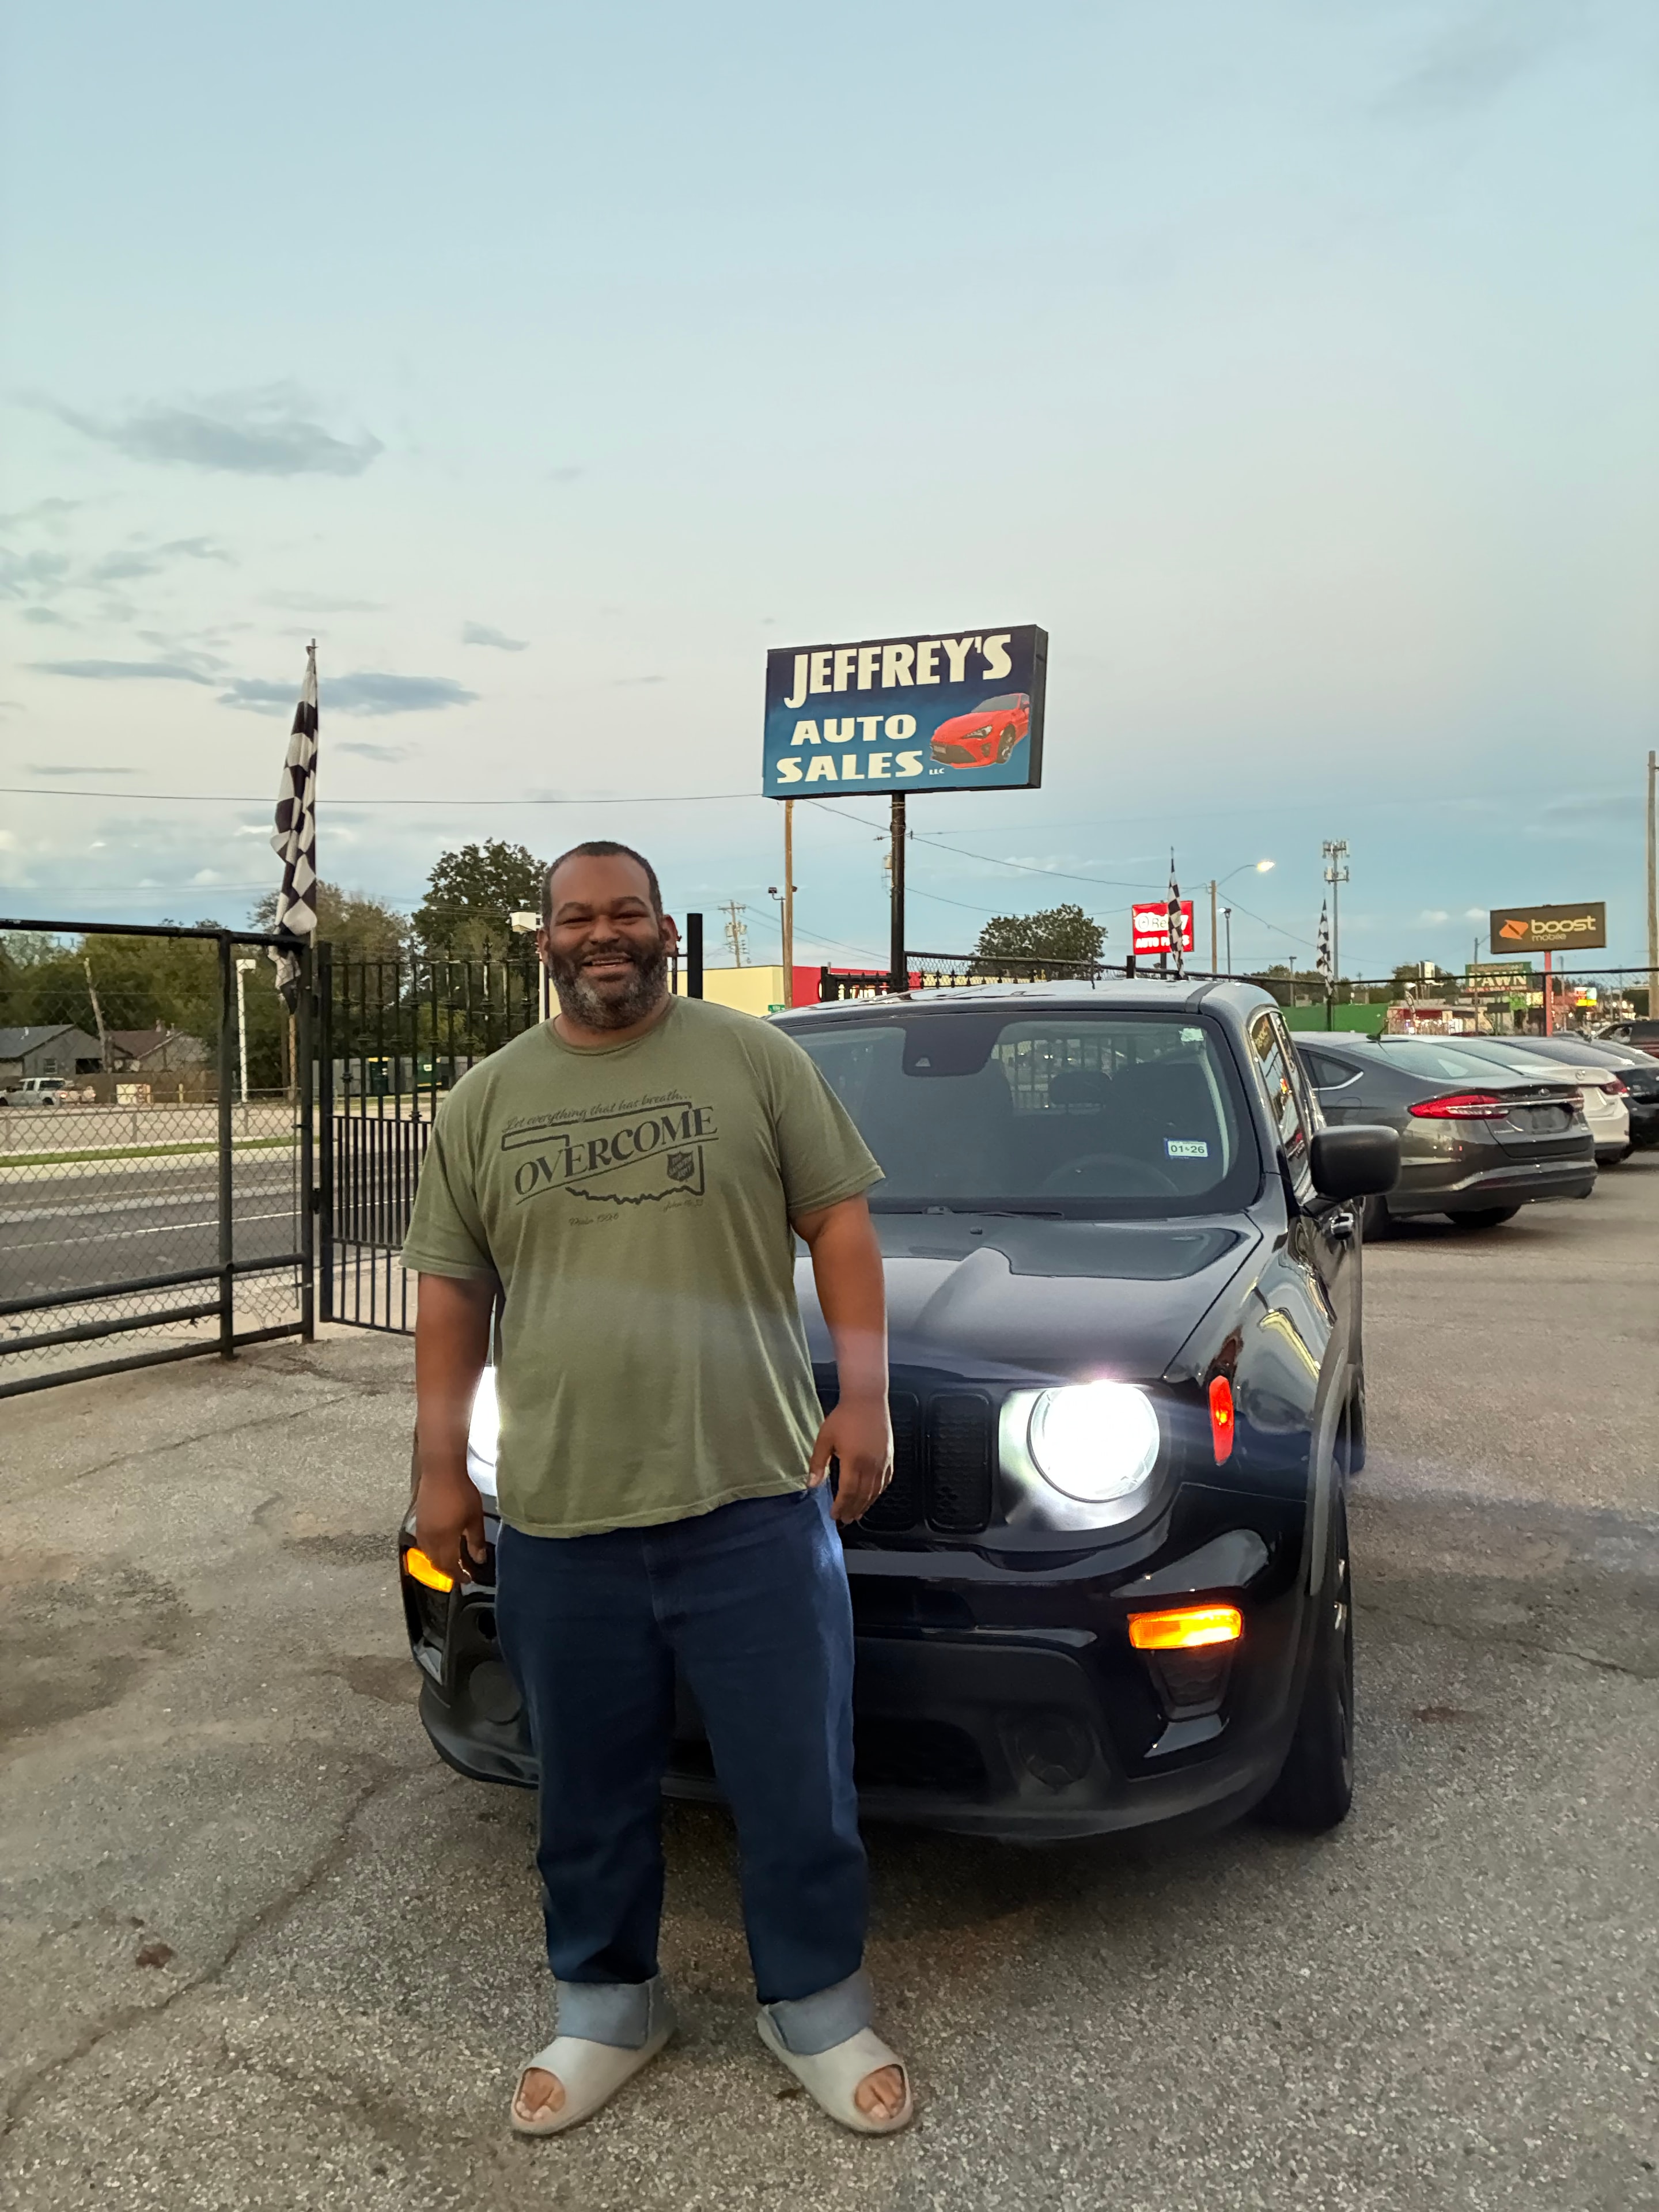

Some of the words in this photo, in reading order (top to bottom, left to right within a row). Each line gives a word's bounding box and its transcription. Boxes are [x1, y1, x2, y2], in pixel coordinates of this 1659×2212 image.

[783, 634, 1012, 709] JEFFREY'S
[790, 714, 916, 746] AUTO
[776, 751, 924, 783] SALES
[1531, 915, 1596, 934] boost
[1532, 933, 1567, 942] mobile
[1468, 971, 1527, 987] PAWN
[515, 1106, 718, 1195] OVERCOME
